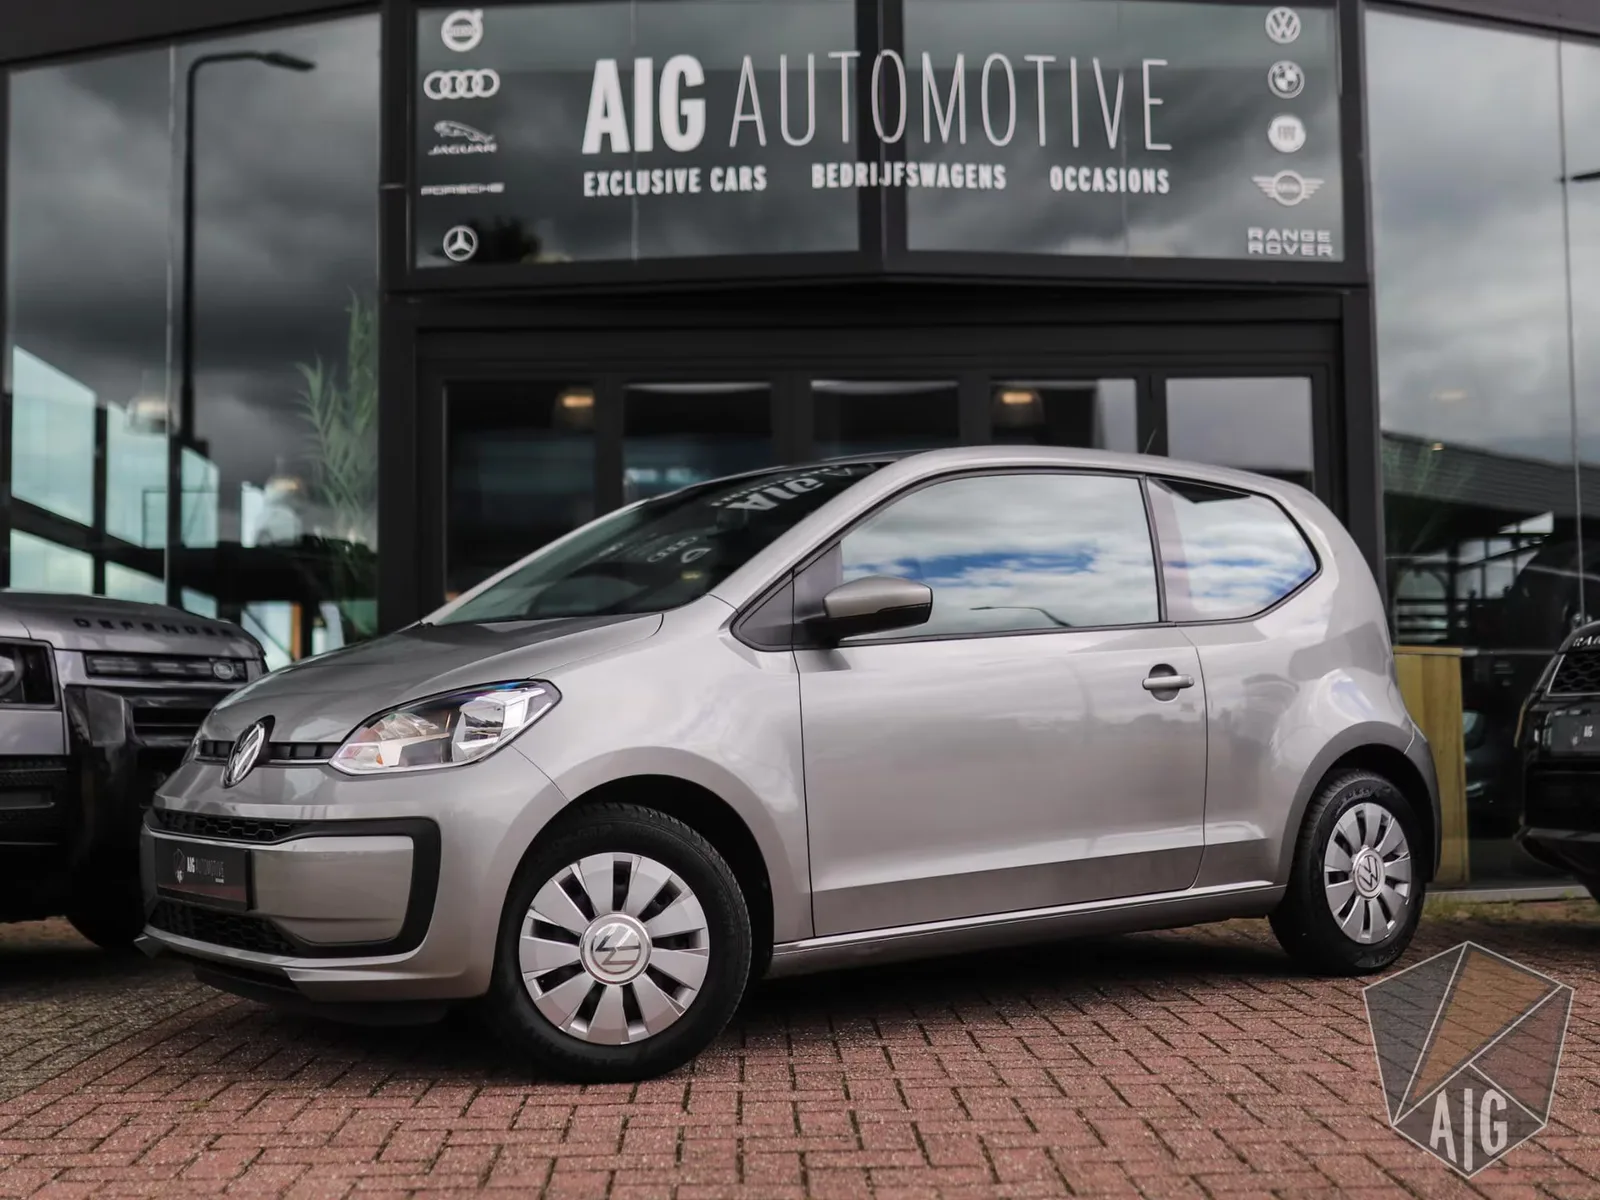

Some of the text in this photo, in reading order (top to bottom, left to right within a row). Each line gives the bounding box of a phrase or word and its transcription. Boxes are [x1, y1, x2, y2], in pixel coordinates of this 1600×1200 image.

[582, 49, 1172, 155] AIG AUTOMOTIVE
[583, 166, 767, 197] EXCLUSIVE CARS
[811, 161, 1007, 191] BEDRIJFSWAGENS
[1050, 165, 1171, 195] OCCASIONS
[1247, 226, 1332, 242] RANGE
[1247, 241, 1334, 258] ROVER
[73, 617, 234, 638] DEFENDER
